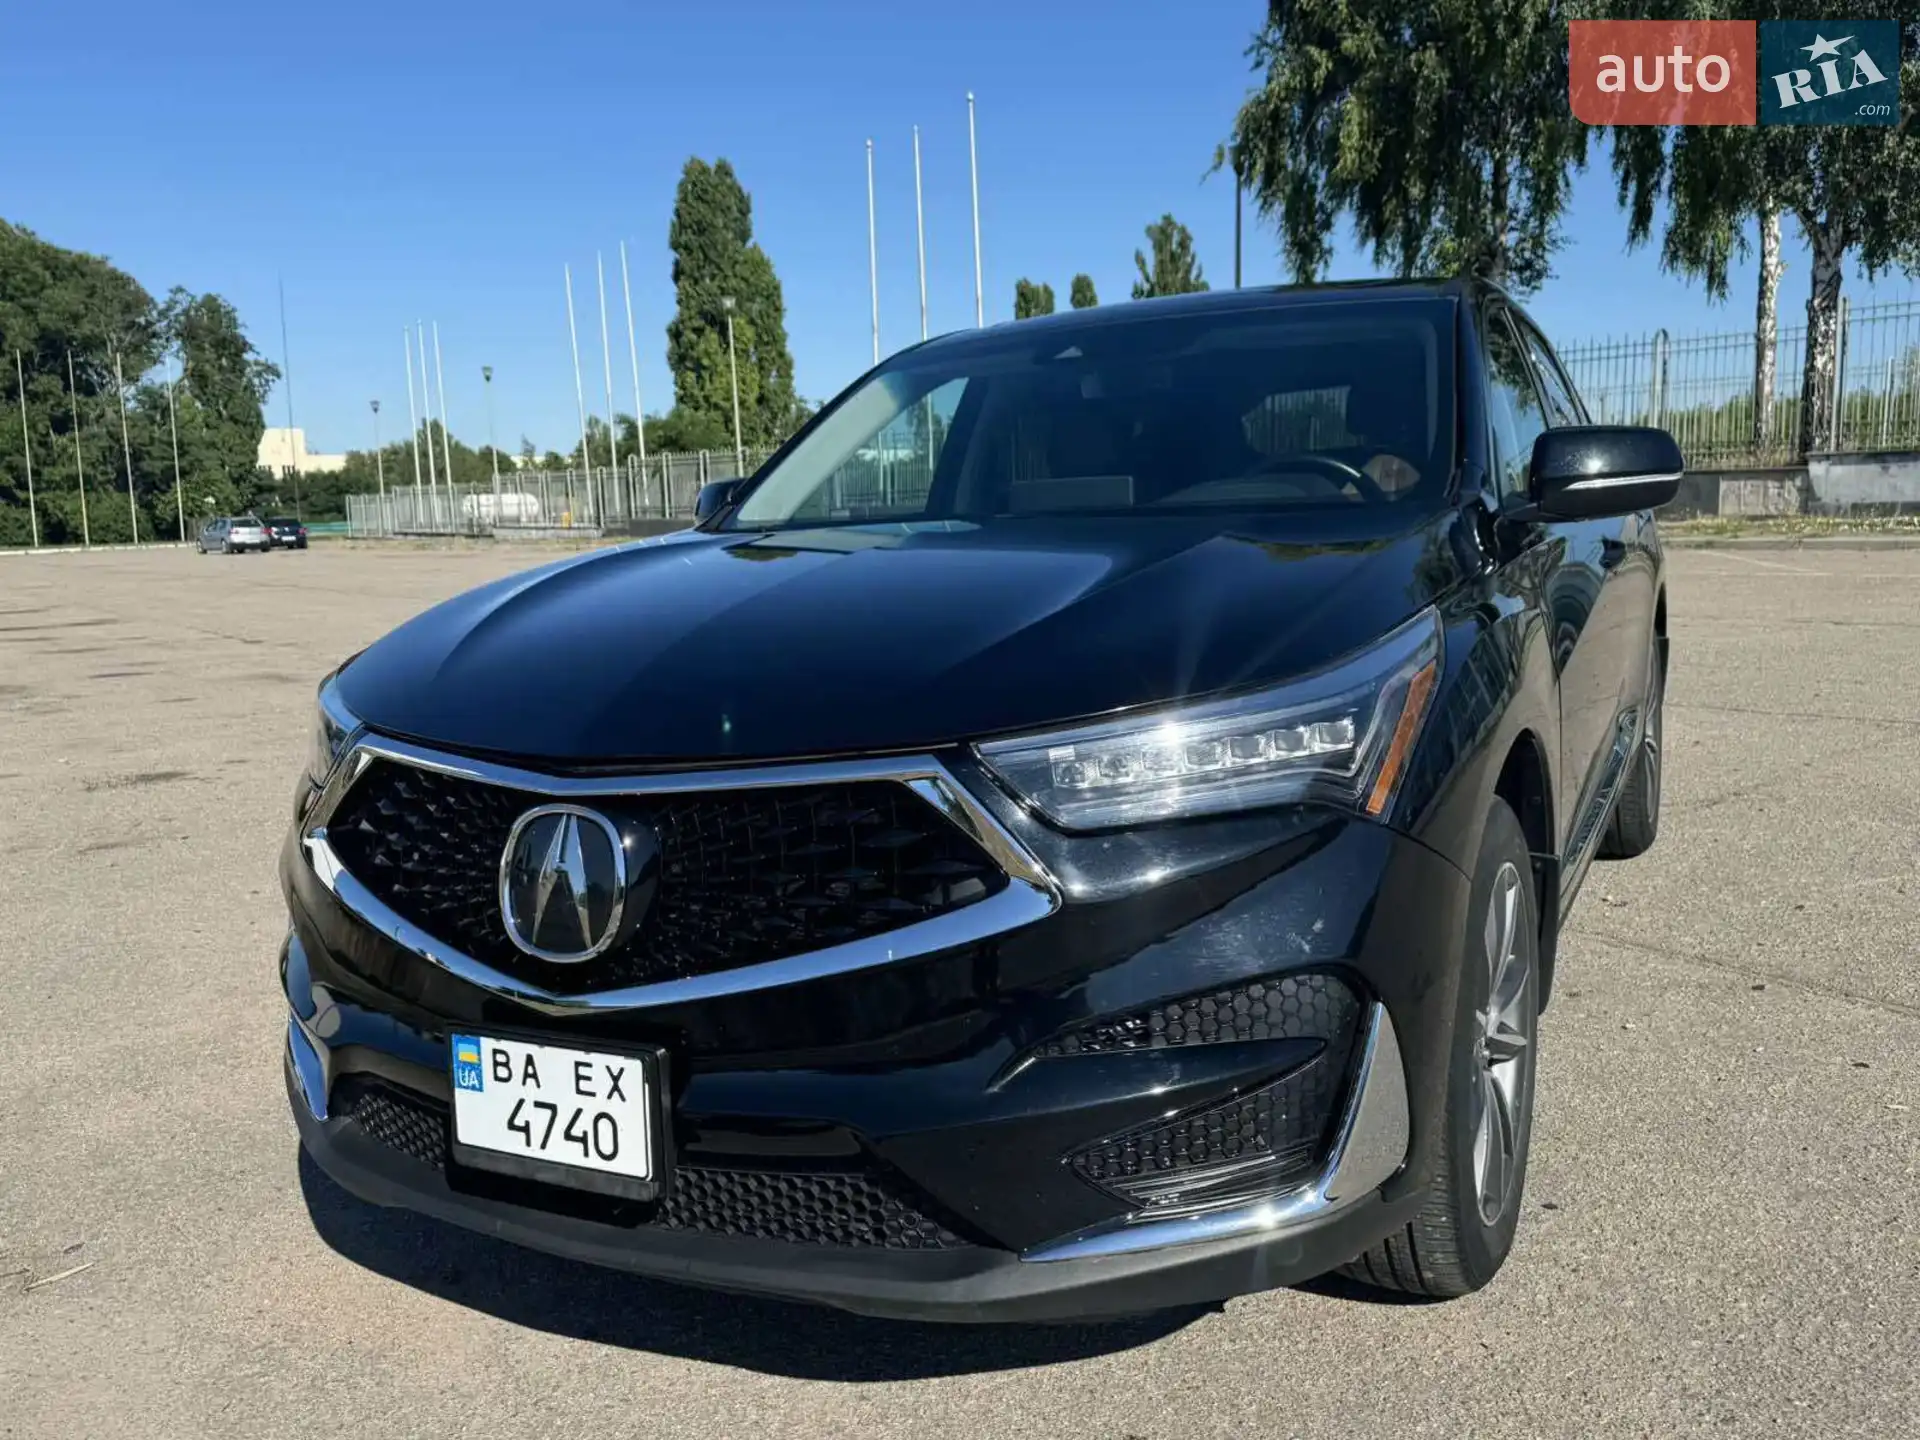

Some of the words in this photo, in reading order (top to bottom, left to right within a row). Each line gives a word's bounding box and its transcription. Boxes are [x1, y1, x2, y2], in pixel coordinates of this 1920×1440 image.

[459, 1070, 480, 1088] UA
[492, 1048, 541, 1089] BA
[574, 1060, 626, 1103] EX
[507, 1098, 619, 1162] 4740
